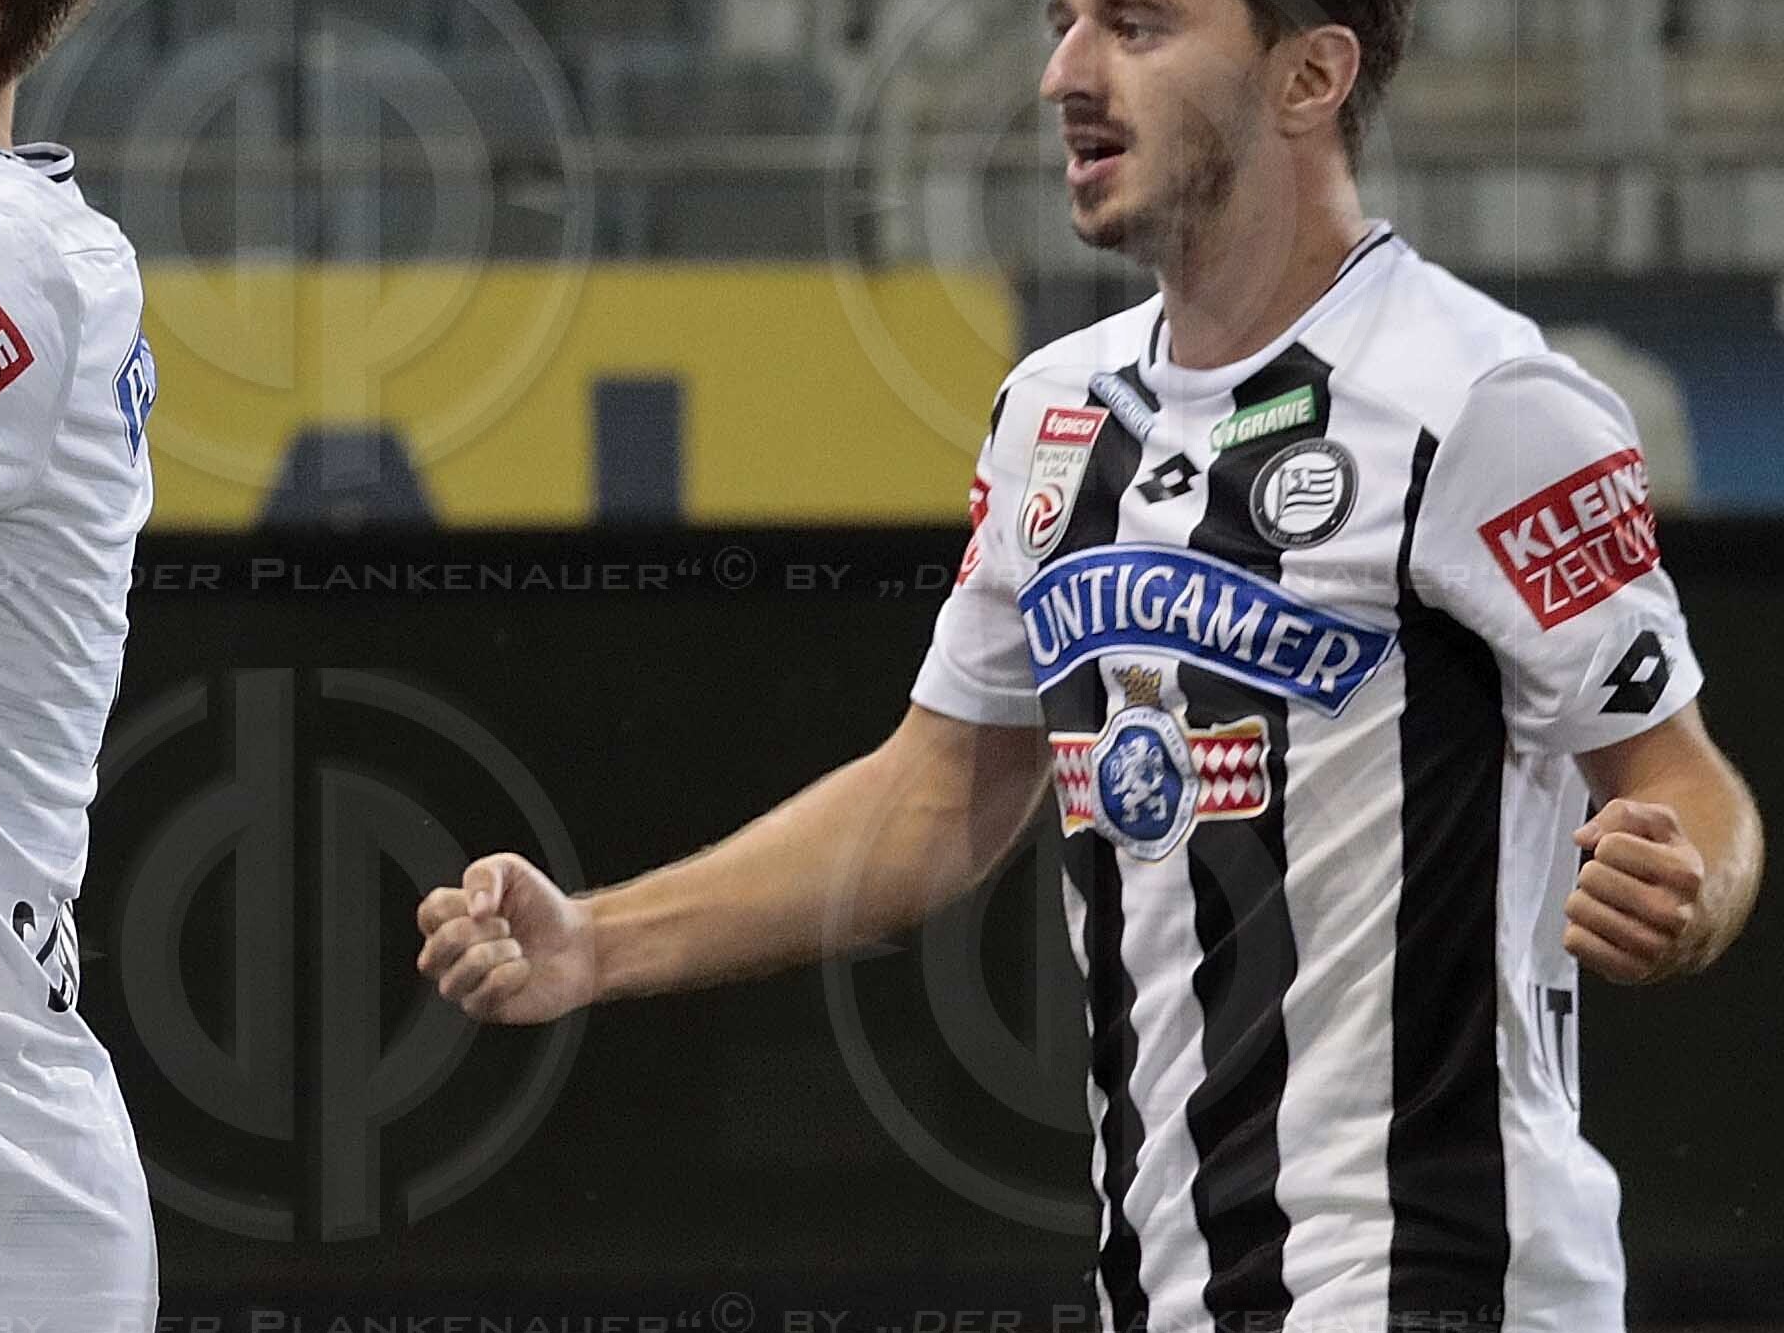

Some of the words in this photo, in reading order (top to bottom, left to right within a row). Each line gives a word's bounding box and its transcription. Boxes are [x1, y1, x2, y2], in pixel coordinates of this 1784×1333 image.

[1238, 400, 1310, 438] GRAWE
[1499, 462, 1649, 570] KLEIN
[1526, 514, 1657, 614] ZEITUN
[1023, 564, 1361, 693] UNTIGAMER
